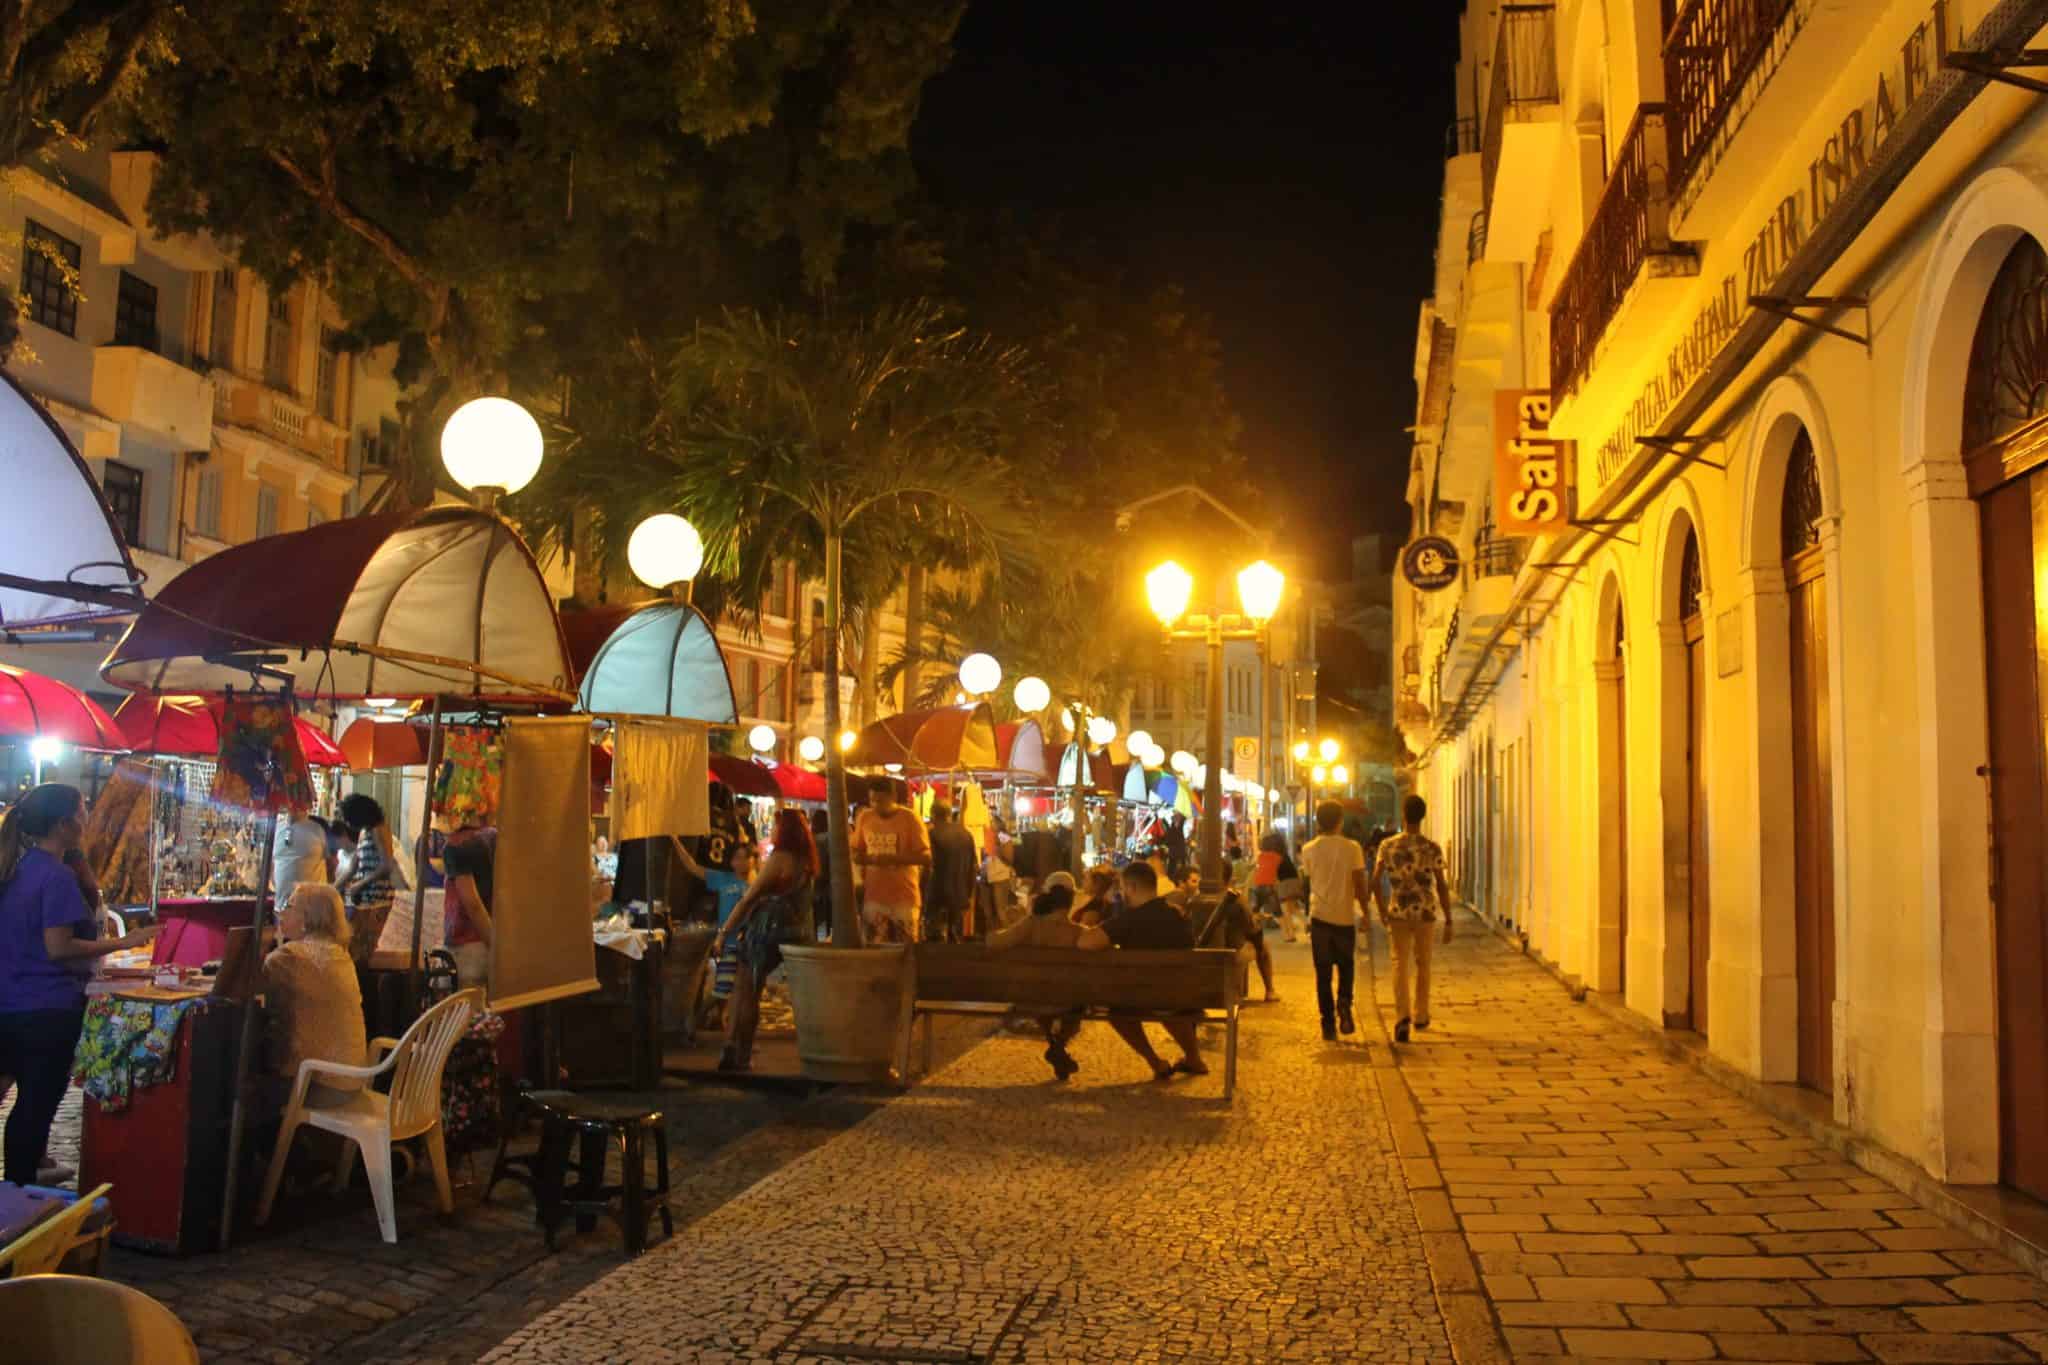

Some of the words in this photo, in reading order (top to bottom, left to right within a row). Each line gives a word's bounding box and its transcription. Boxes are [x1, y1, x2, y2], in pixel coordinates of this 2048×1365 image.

[1667, 273, 1740, 400] KAHAL
[1743, 194, 1800, 301] ZUR
[1808, 0, 1962, 226] ISRAEL
[1507, 395, 1558, 521] Safra
[709, 836, 725, 864] 8
